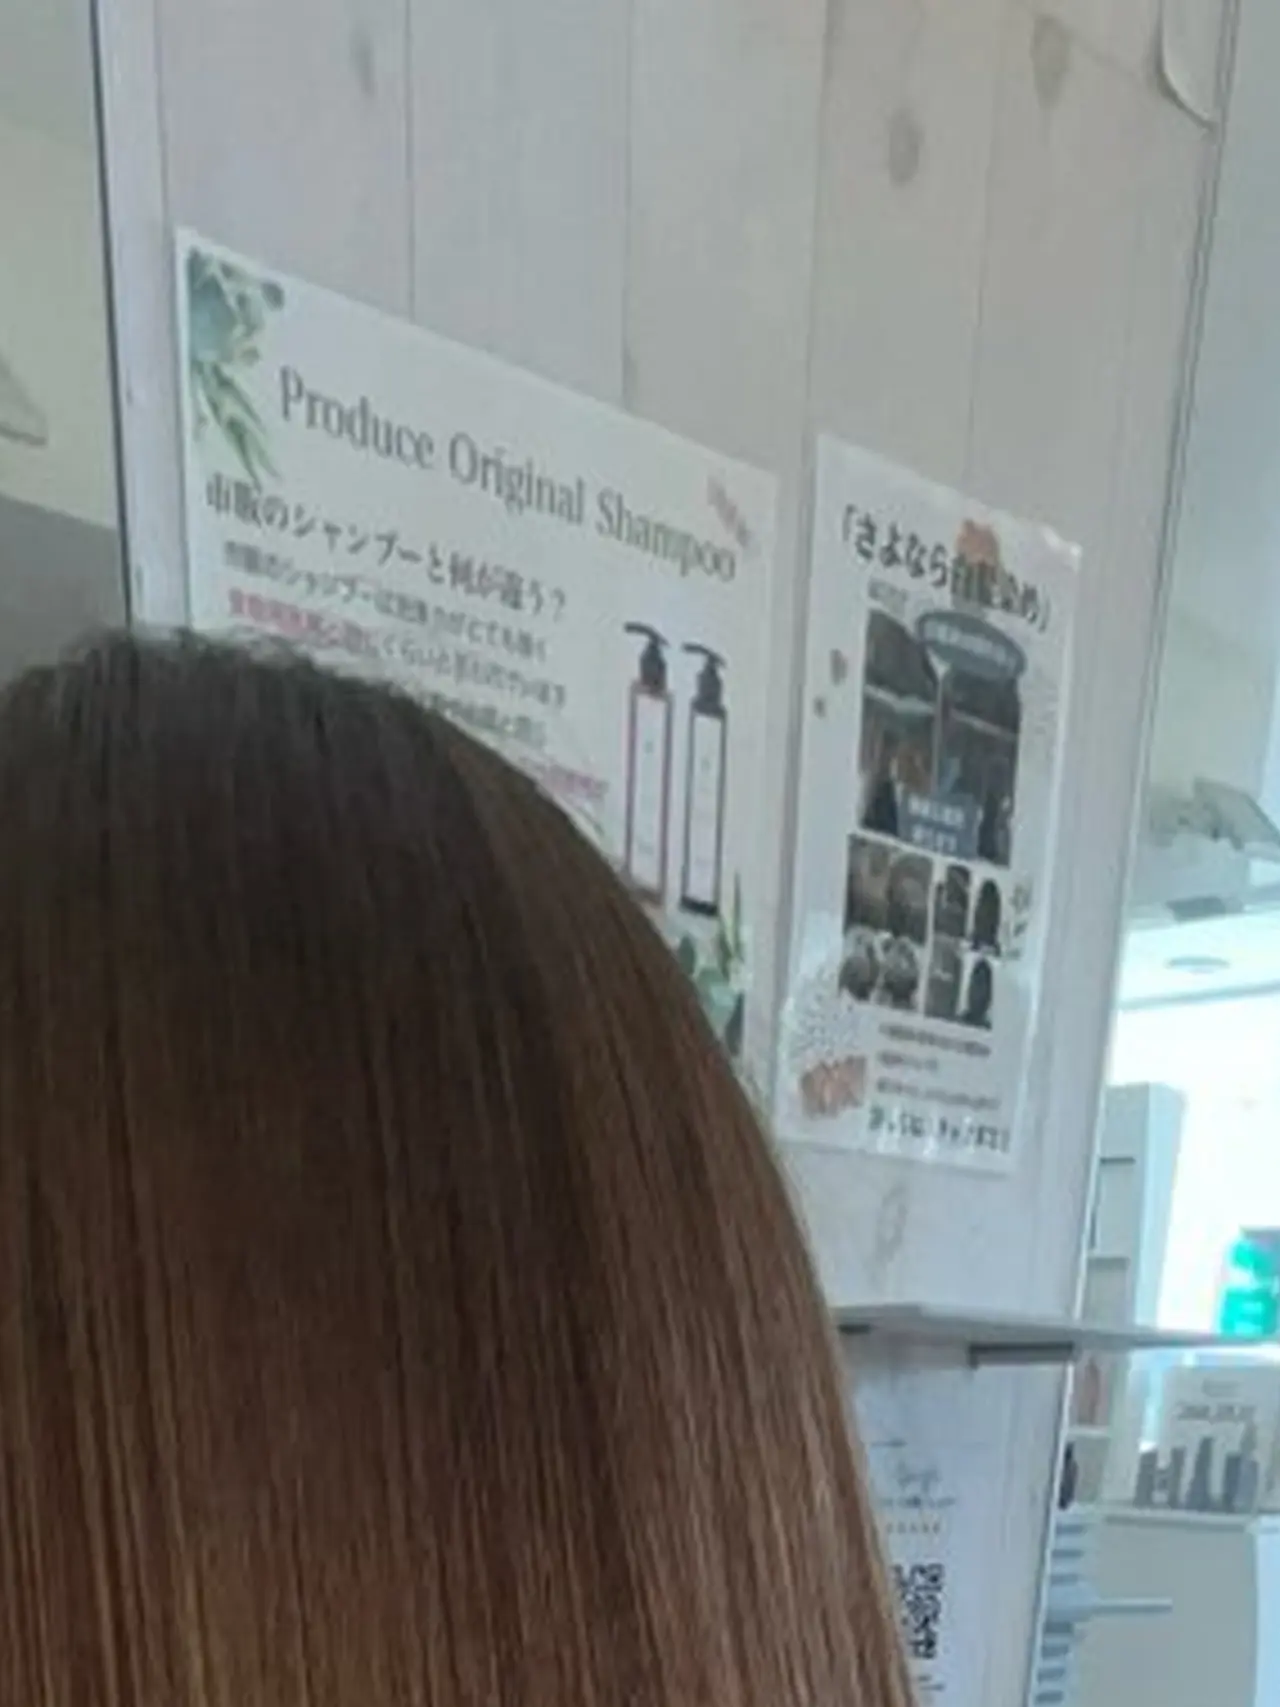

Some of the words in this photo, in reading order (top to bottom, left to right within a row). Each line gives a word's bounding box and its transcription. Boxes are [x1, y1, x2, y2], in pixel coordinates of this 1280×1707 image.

[279, 365, 434, 470] Produce
[448, 431, 586, 519] Original
[596, 487, 738, 583] Shampoo
